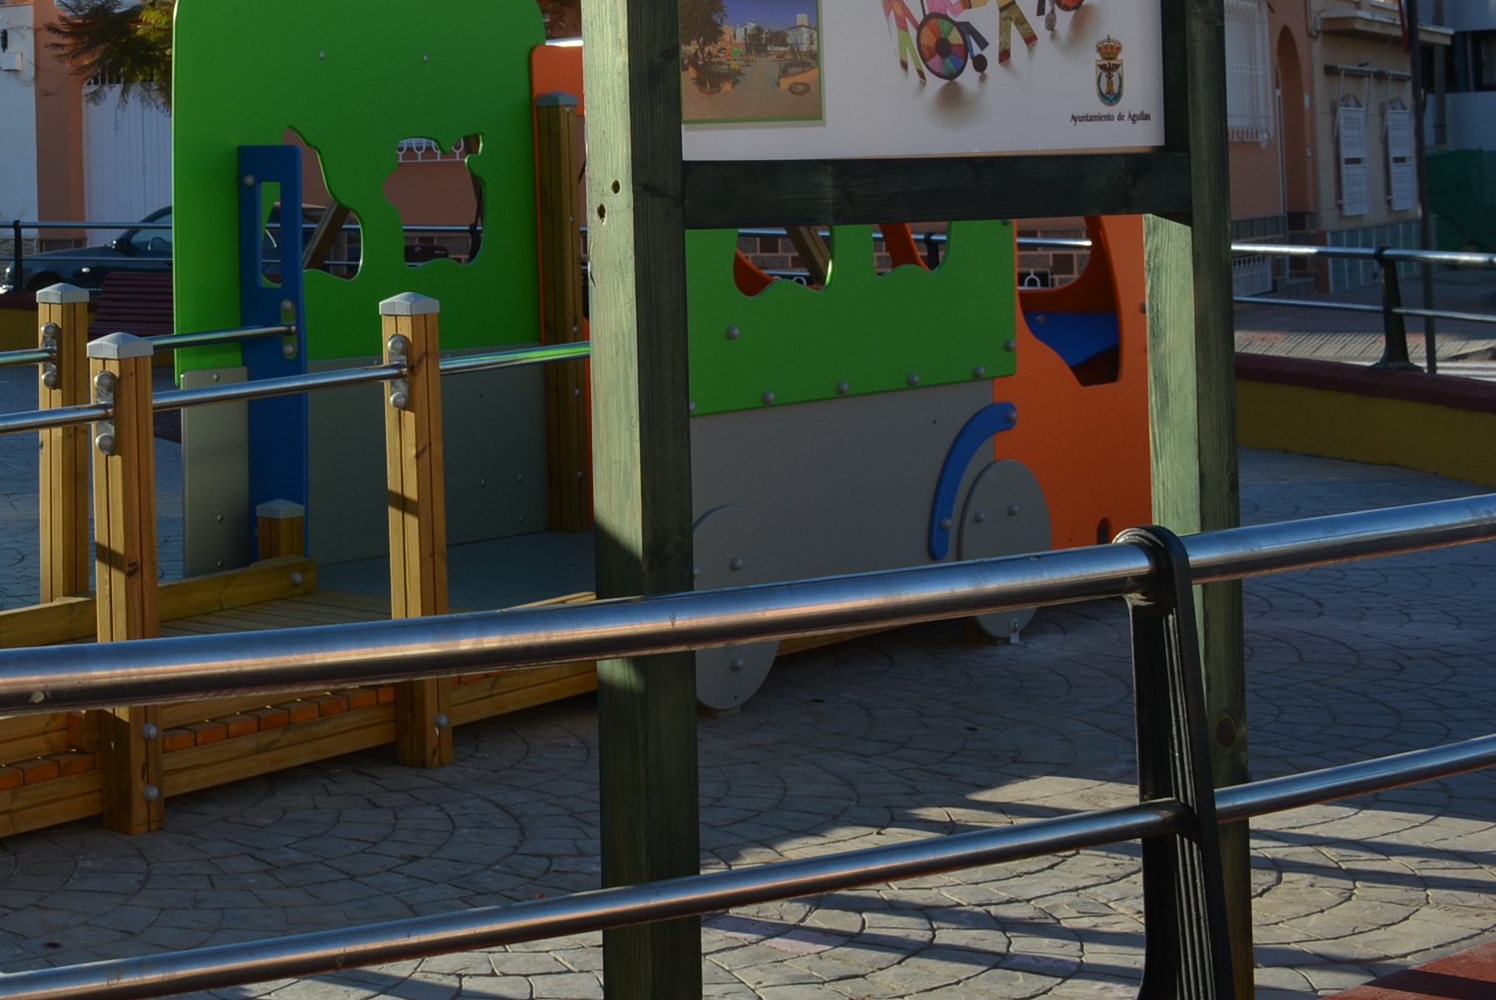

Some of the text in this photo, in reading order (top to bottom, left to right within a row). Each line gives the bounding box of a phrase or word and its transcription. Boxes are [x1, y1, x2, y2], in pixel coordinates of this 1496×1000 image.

[1070, 110, 1151, 126] Ayuntamiento de Águilas
